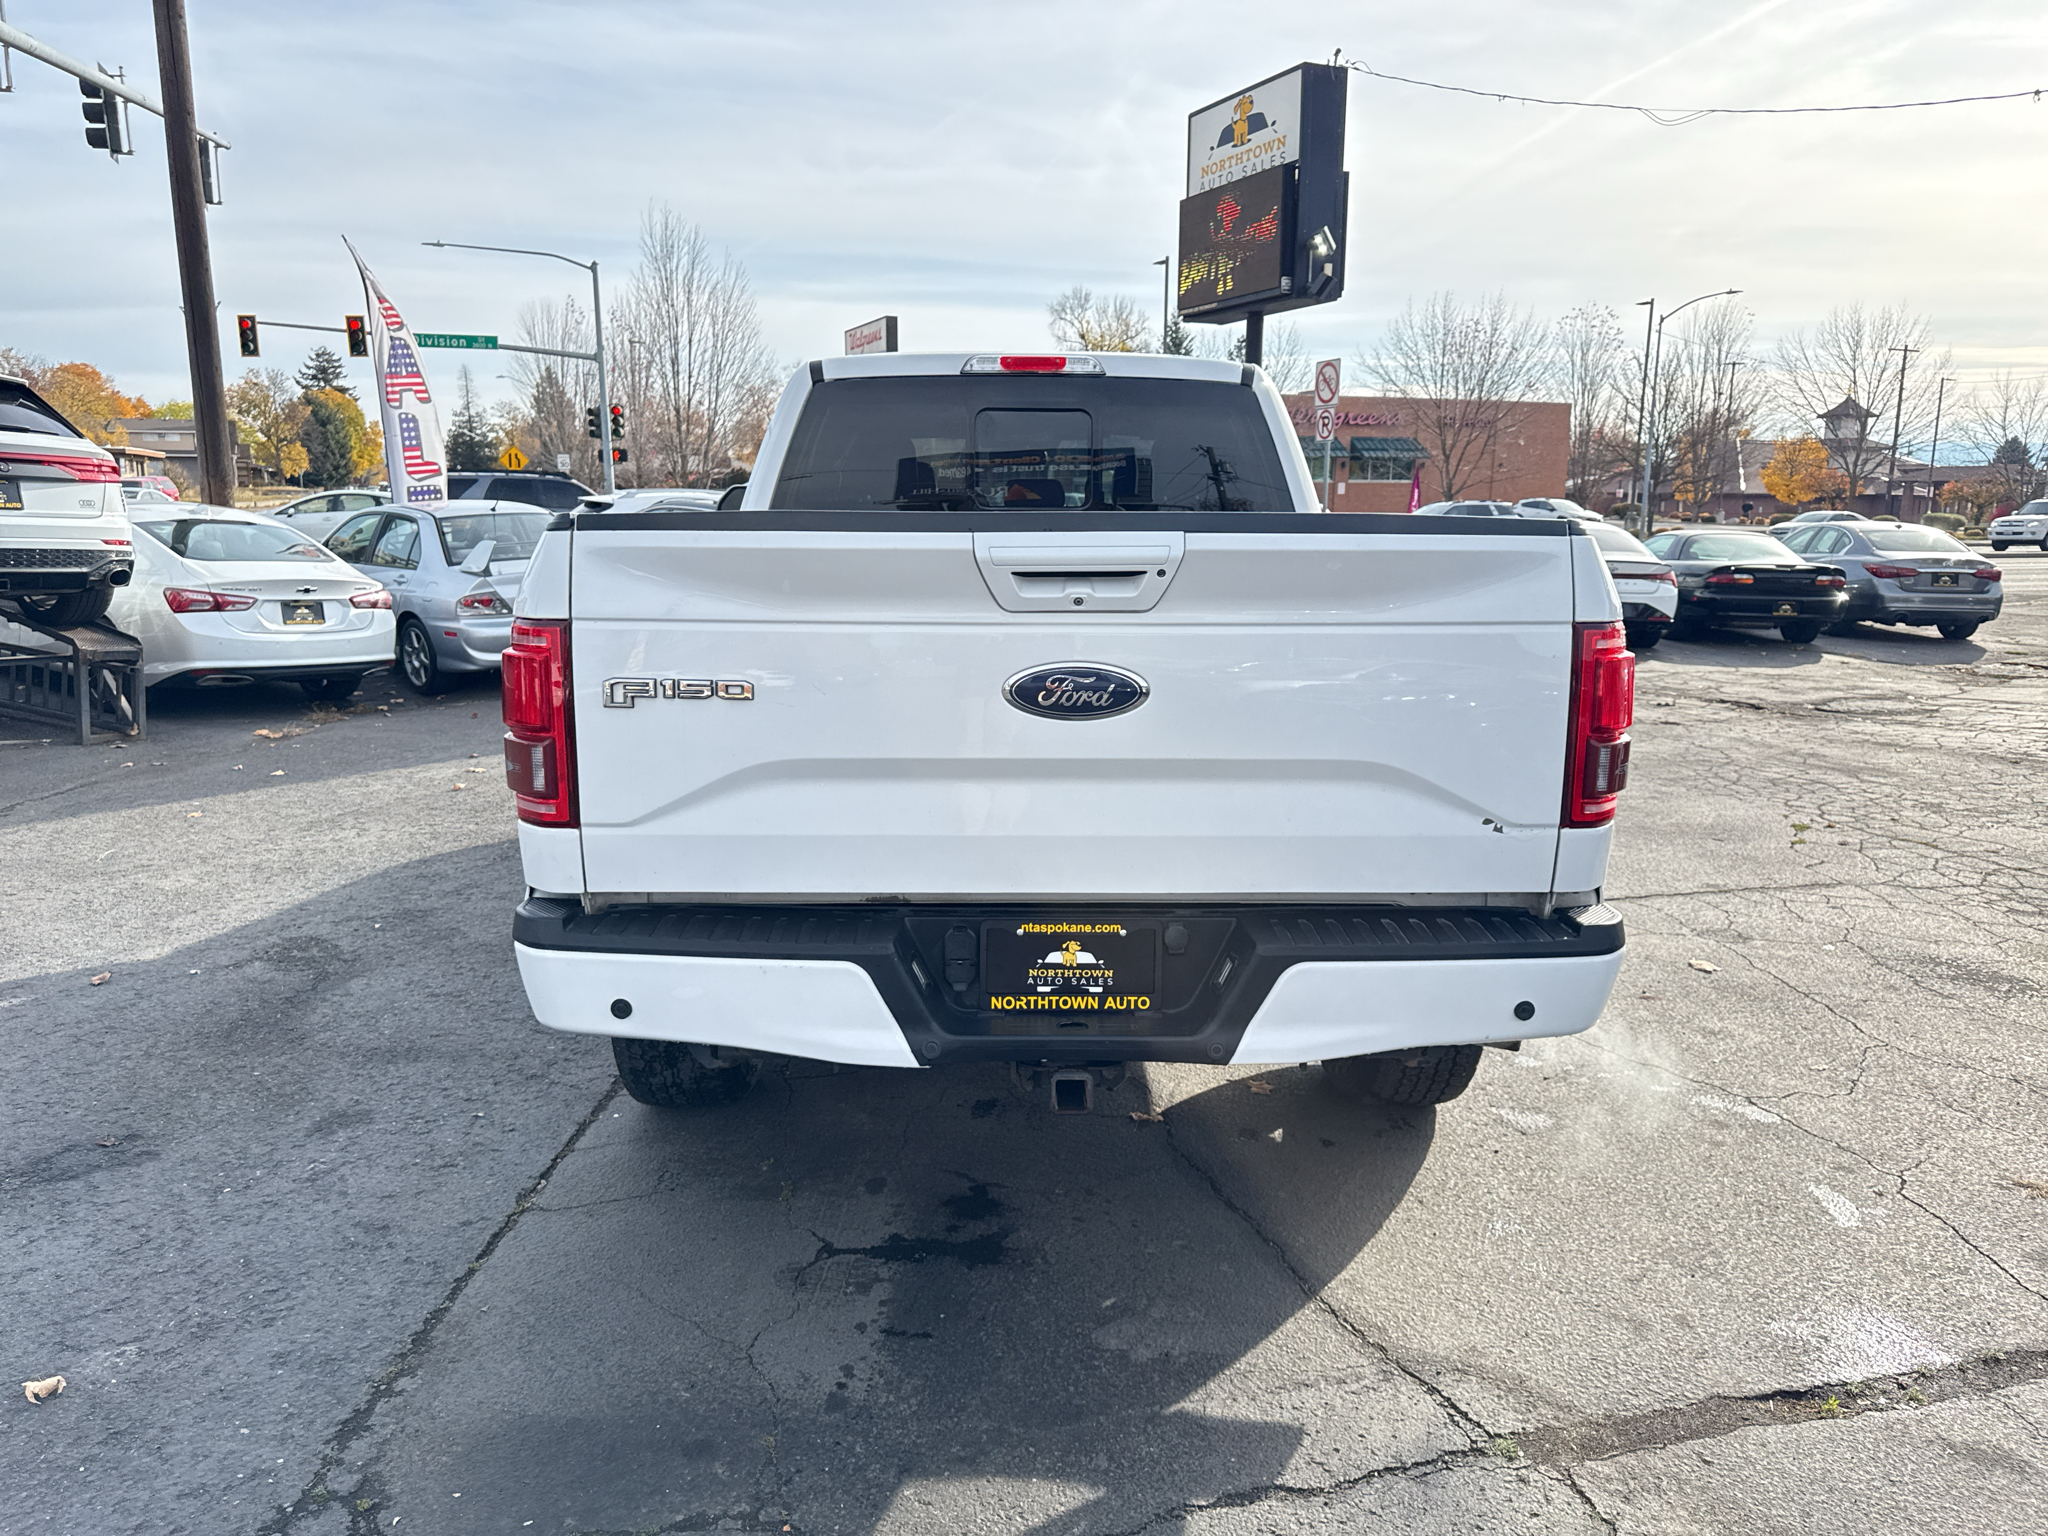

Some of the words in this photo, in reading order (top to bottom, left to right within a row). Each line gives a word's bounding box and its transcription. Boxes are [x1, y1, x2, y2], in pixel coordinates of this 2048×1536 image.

[1201, 135, 1287, 179] NORTHTOWN
[1200, 171, 1233, 192] AUTO
[1242, 151, 1286, 178] SALES
[1288, 406, 1402, 430] Wgreens
[1037, 674, 1116, 707] Ford
[1021, 922, 1122, 934] ntaspokane.com
[1028, 969, 1114, 978] NORTHTOWN
[1072, 978, 1114, 986] SALES
[990, 996, 1098, 1010] NORTHTOWN
[1104, 996, 1150, 1010] AUTO
